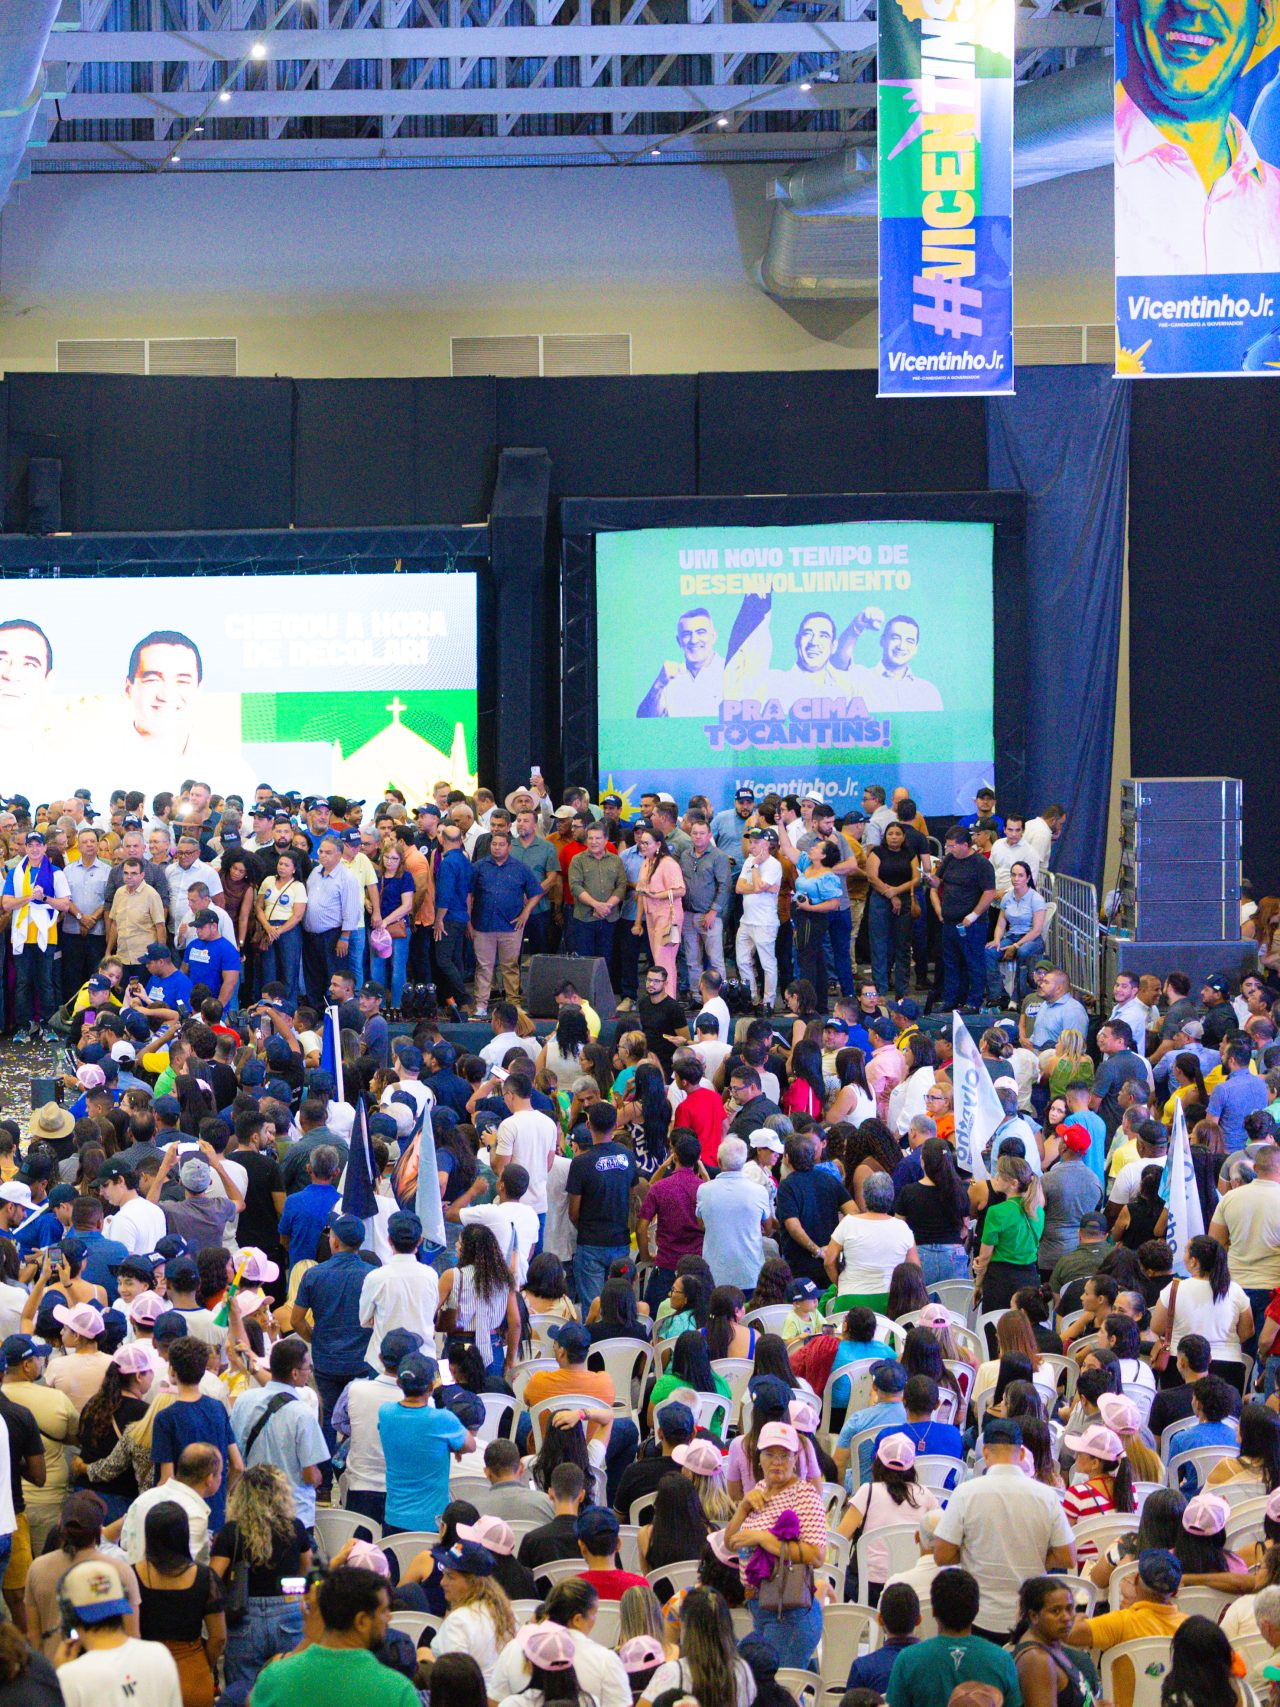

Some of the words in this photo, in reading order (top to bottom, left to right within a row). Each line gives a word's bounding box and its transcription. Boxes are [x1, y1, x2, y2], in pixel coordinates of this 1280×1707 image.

[1128, 294, 1250, 320] Vicentinho
[1250, 293, 1274, 318] Jr.
[888, 351, 985, 371] Vicentinho
[985, 350, 1004, 370] Jr.
[679, 548, 718, 569] UM
[725, 547, 783, 568] NOVO
[789, 545, 871, 567] TEMPO
[878, 544, 909, 565] DE
[680, 569, 911, 595] DESENVOLVIMENTO
[719, 698, 785, 722] PRA
[704, 720, 891, 751] TOCANTINS!
